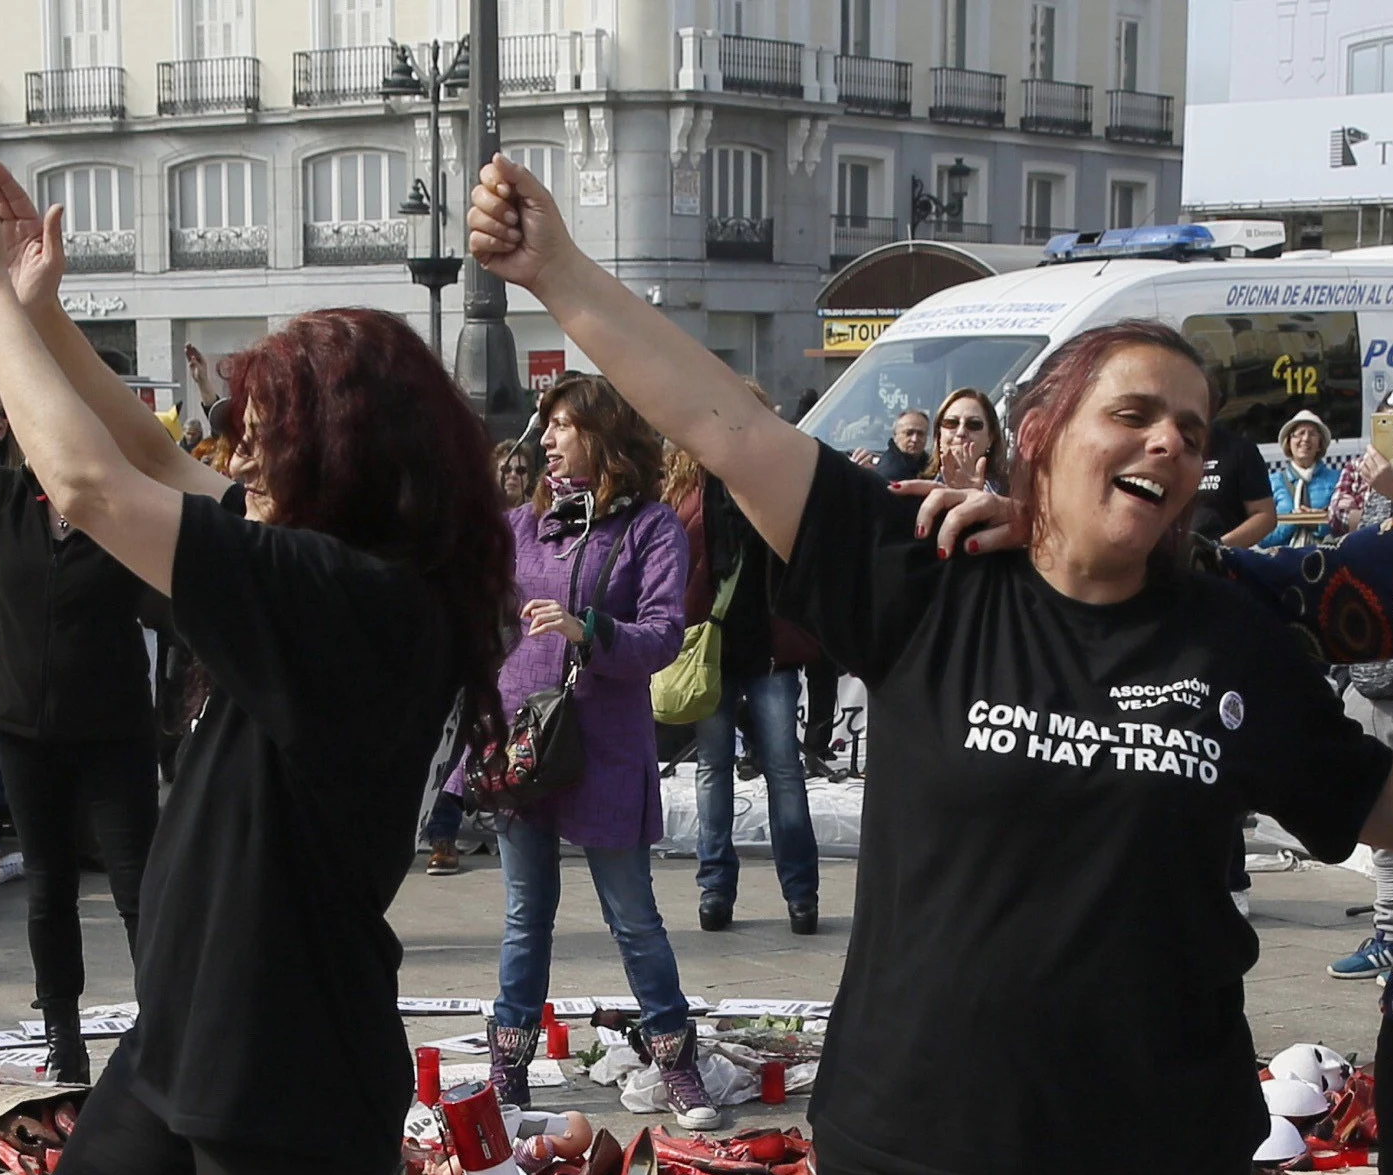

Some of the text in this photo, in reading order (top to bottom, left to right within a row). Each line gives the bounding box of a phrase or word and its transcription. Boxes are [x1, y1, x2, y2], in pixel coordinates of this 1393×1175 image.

[1227, 285, 1280, 306] OFICINA
[1283, 286, 1300, 305] DE
[1301, 281, 1364, 305] ATENCIÓN
[1365, 286, 1382, 304] AL
[1283, 366, 1318, 394] 112
[1109, 677, 1210, 699] ASOCIACIÓN
[1117, 691, 1202, 711] VE-LA LUZ
[967, 700, 1221, 761] CON MALTRATO
[964, 727, 1218, 785] NO HAY TRATO
